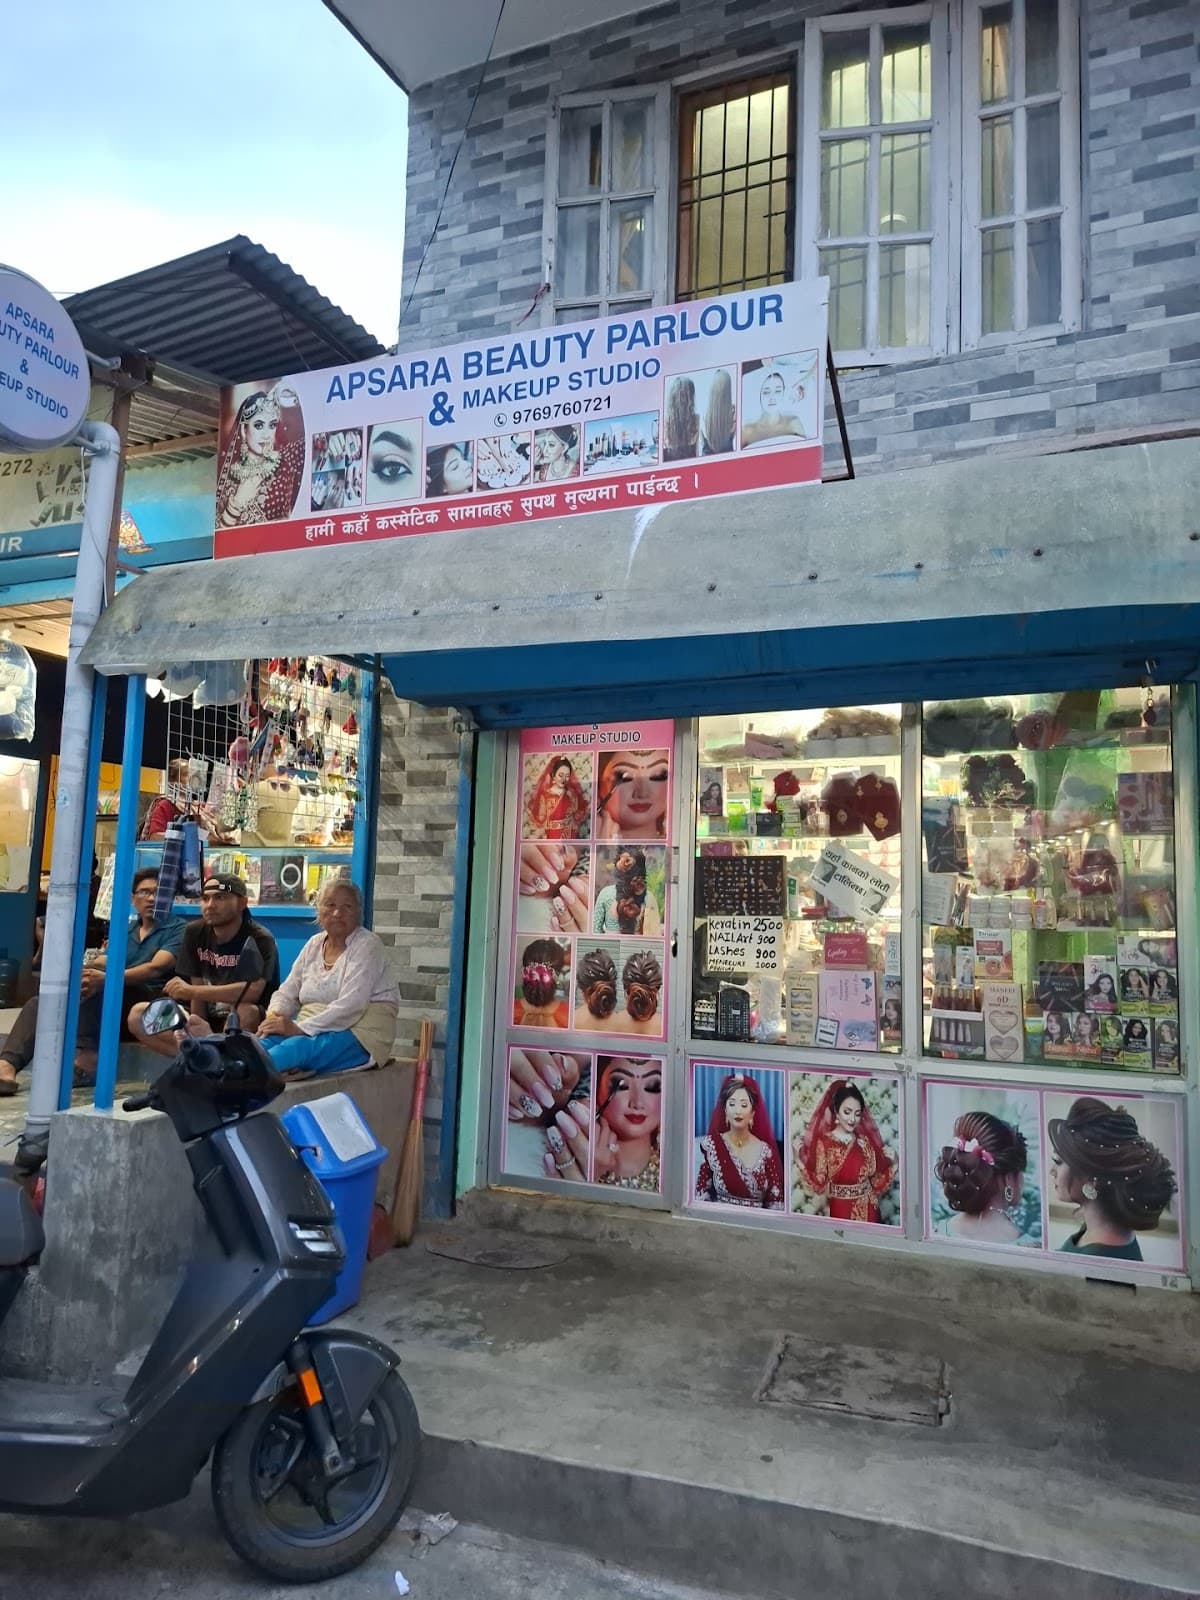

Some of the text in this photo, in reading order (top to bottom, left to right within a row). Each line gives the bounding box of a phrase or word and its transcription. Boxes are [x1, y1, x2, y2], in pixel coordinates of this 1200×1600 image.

[6, 302, 55, 343] APSARA
[25, 336, 79, 379] PARLOUR
[327, 294, 783, 403] APSARA BEAUTY PARLOUR
[20, 359, 29, 376] &
[26, 386, 69, 419] STUDIO
[429, 358, 661, 426] & MAKEUP STUDIO
[513, 395, 611, 424] 9769760721
[0, 458, 33, 477] 272
[305, 519, 336, 541] हामी
[342, 512, 370, 535] कहाँ
[376, 508, 440, 531] कस्मेटिक
[448, 500, 513, 522] सामानहरु
[520, 493, 556, 516] सुपथ
[564, 485, 619, 511] मुल्यमा
[627, 475, 682, 497] पाईन्छ
[552, 731, 641, 745] MAKEUP STUDIO
[752, 917, 783, 932] 2500
[756, 934, 776, 945] 900
[755, 961, 777, 969] 1000
